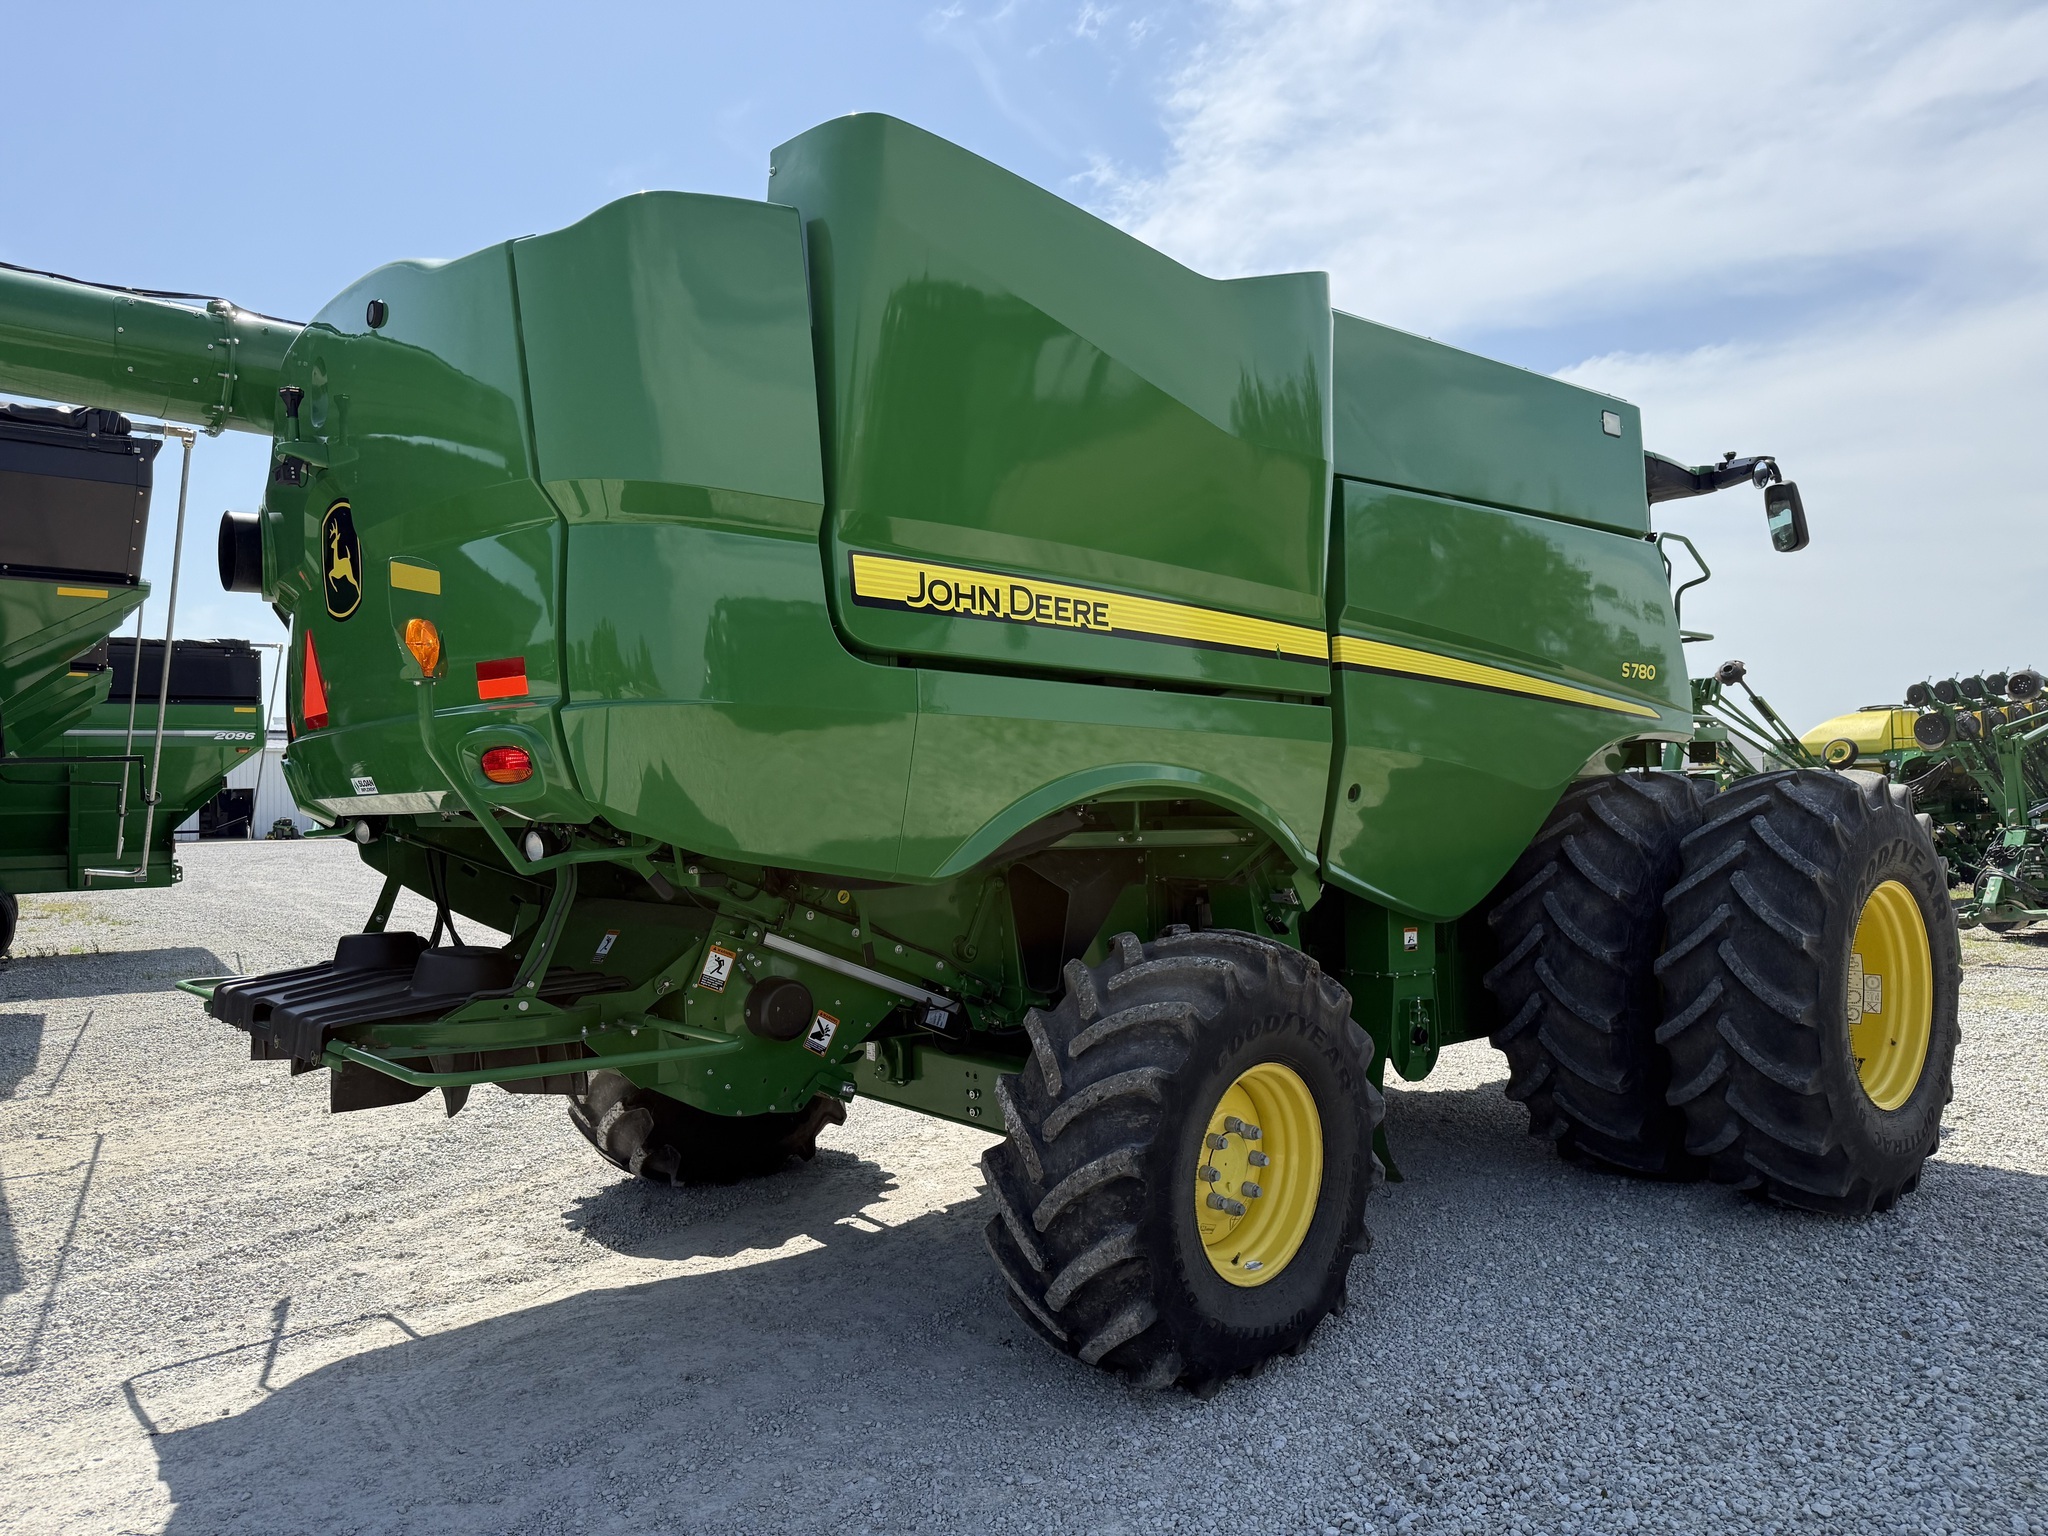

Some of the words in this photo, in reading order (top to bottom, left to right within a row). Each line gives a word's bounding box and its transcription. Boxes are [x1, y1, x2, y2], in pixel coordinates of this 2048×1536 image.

[906, 571, 1001, 614] JOHN
[1009, 584, 1110, 628] DEERE
[1621, 661, 1656, 680] S780
[213, 731, 256, 740] 2096
